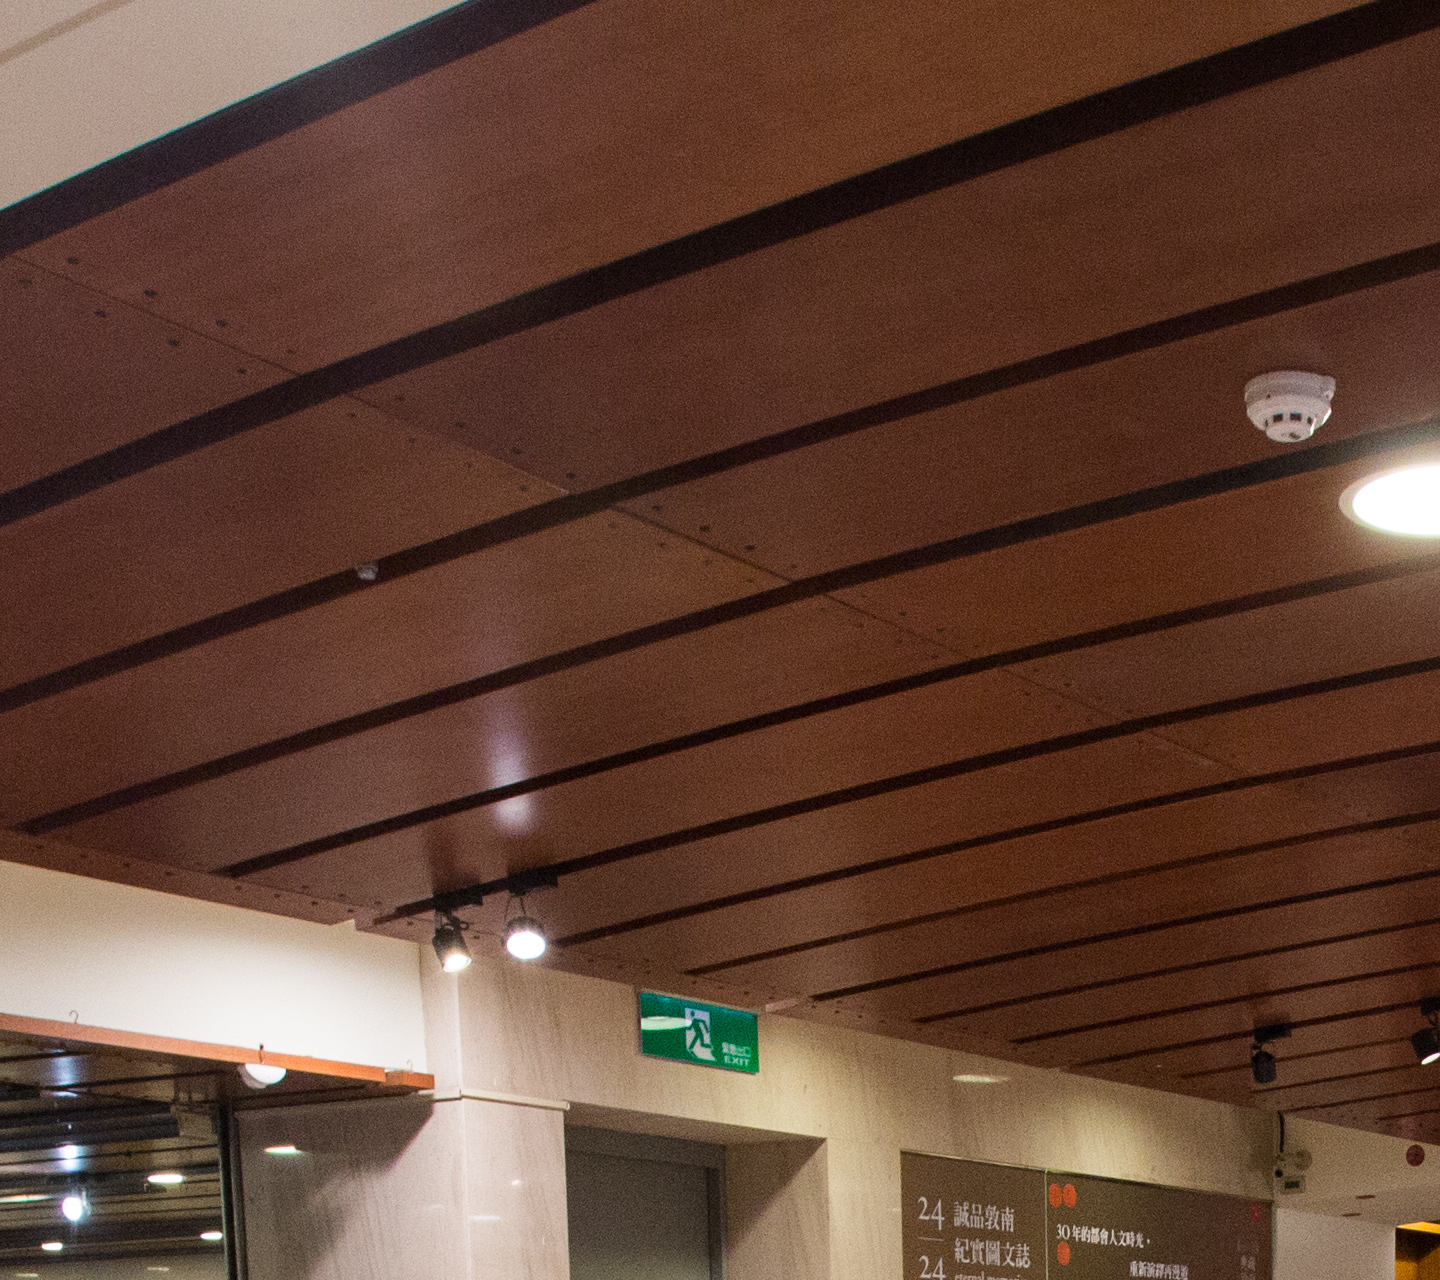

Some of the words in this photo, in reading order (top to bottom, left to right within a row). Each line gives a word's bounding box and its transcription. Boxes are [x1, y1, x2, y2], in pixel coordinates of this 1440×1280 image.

[723, 1055, 750, 1067] EXIT
[918, 1196, 945, 1231] 24
[953, 1201, 1015, 1232] 誠品敦南
[954, 1237, 1031, 1269] 紀實圖文誌
